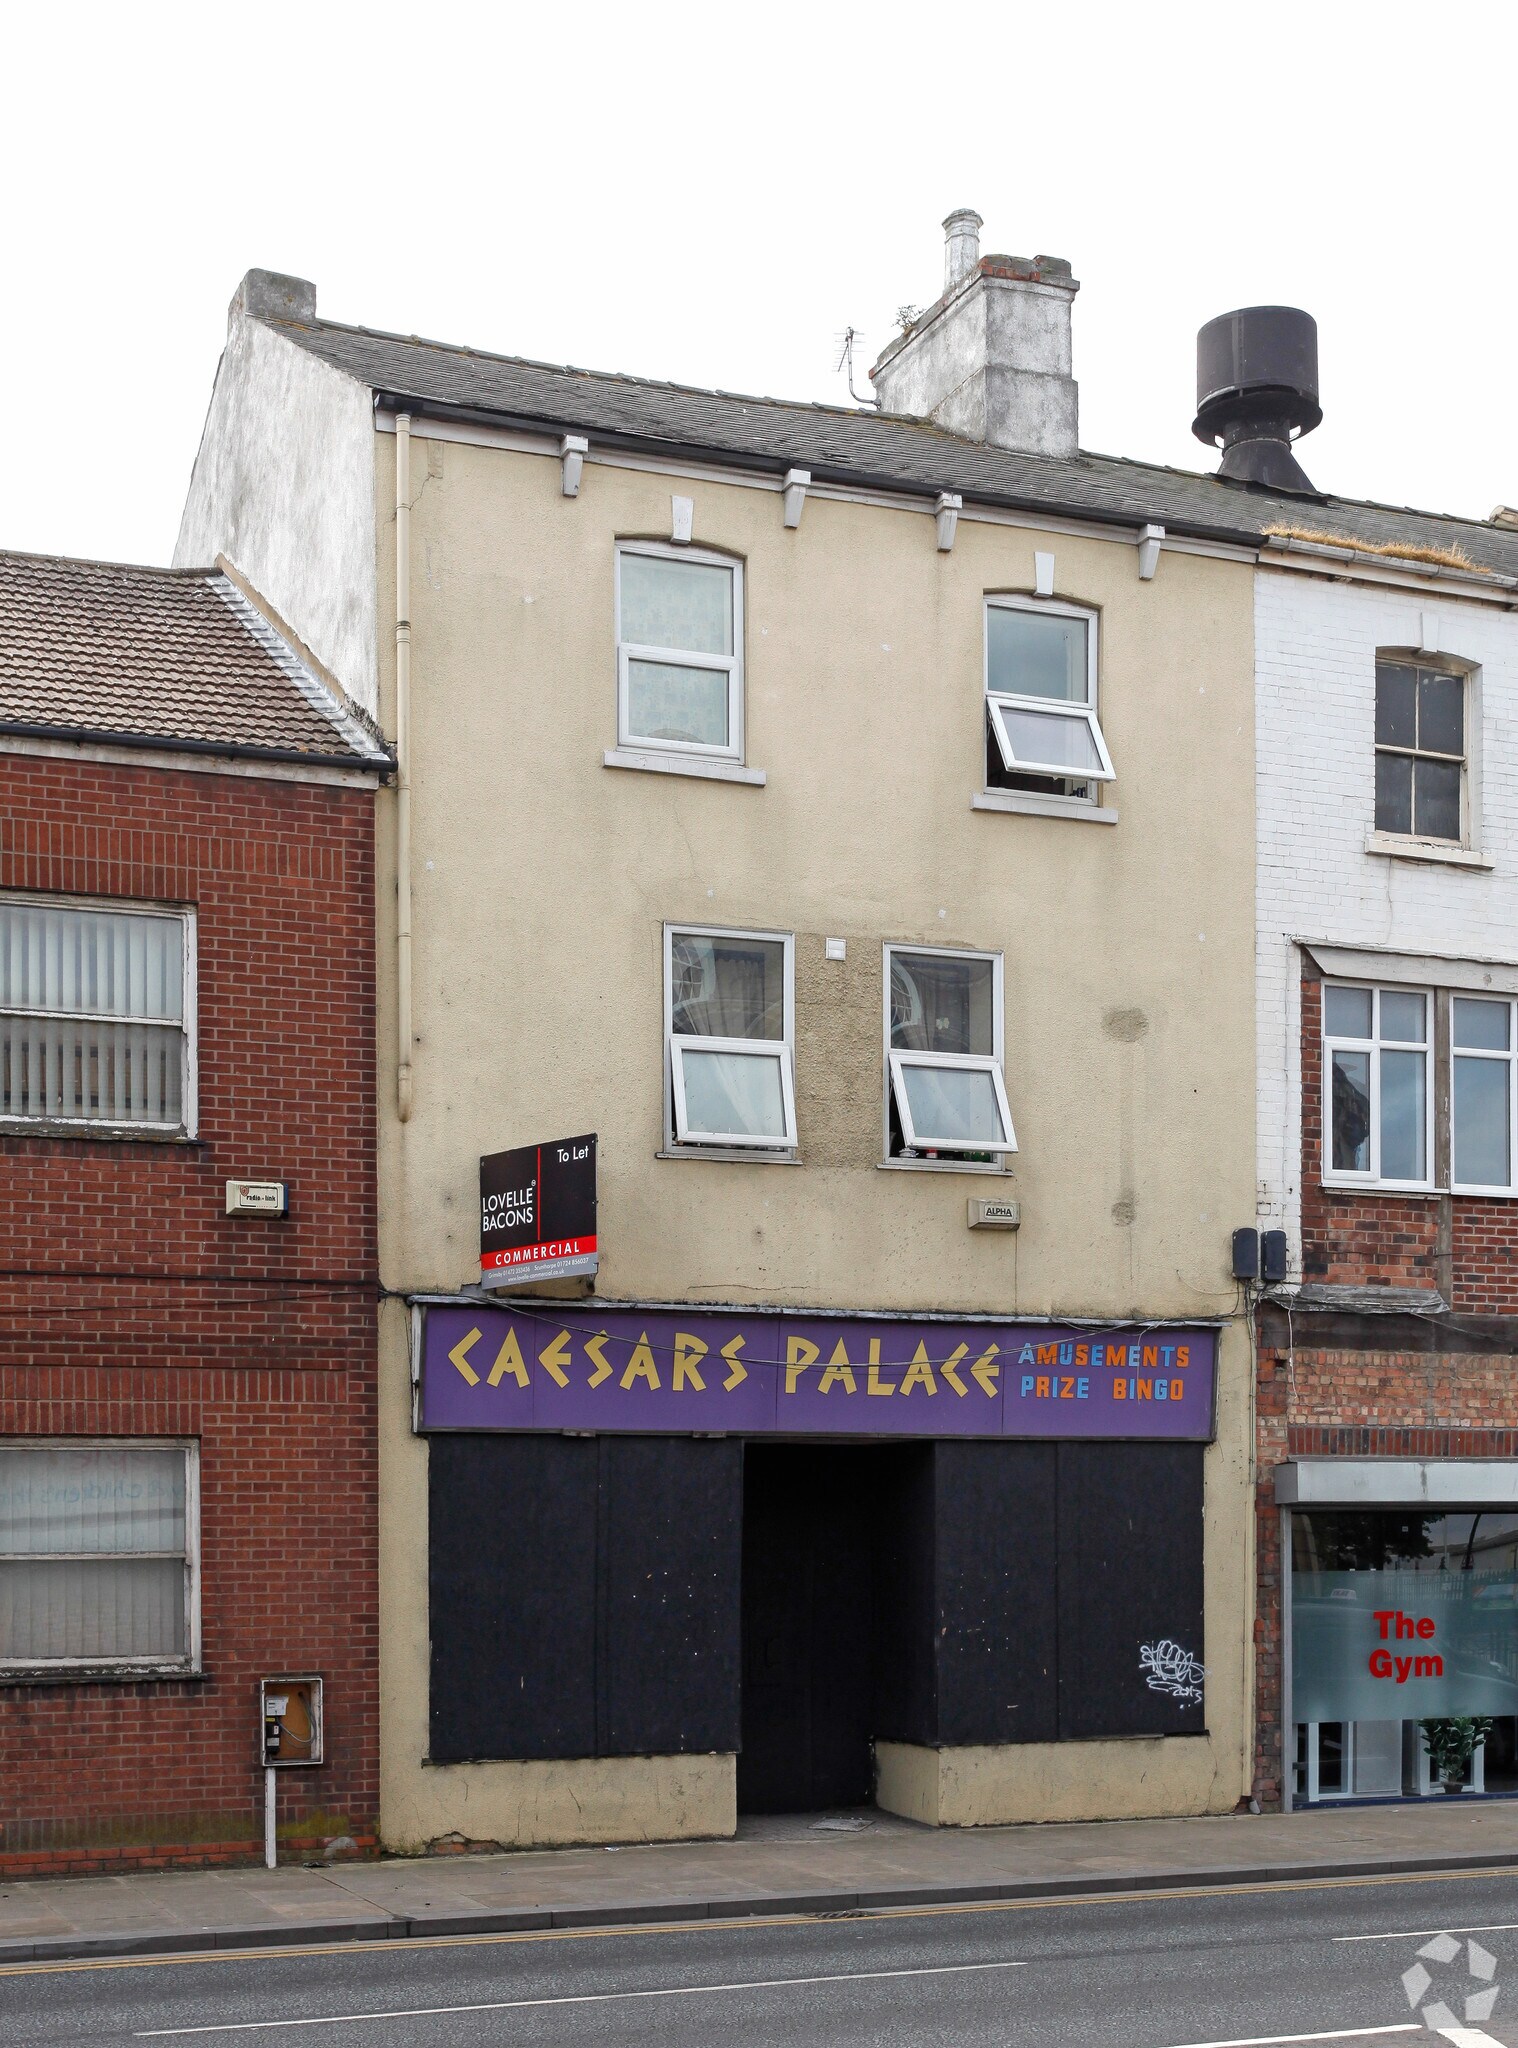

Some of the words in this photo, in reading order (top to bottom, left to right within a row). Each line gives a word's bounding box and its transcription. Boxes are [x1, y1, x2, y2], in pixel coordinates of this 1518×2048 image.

[557, 1149, 570, 1163] To
[573, 1145, 589, 1160] Let
[482, 1187, 533, 1213] LOVELLE
[986, 1207, 1012, 1217] ALPHA
[482, 1207, 534, 1232] BACONS
[495, 1241, 580, 1266] COMMERCIAL
[534, 1263, 556, 1272] Scunthorpe
[448, 1326, 748, 1393] CAESARS
[785, 1335, 1001, 1399] PALACE
[1018, 1342, 1191, 1368] AMUSEMENTS
[1020, 1375, 1090, 1399] PRIZE
[1113, 1379, 1184, 1401] BINGO
[1373, 1611, 1436, 1640] The
[1368, 1648, 1443, 1684] Gym
